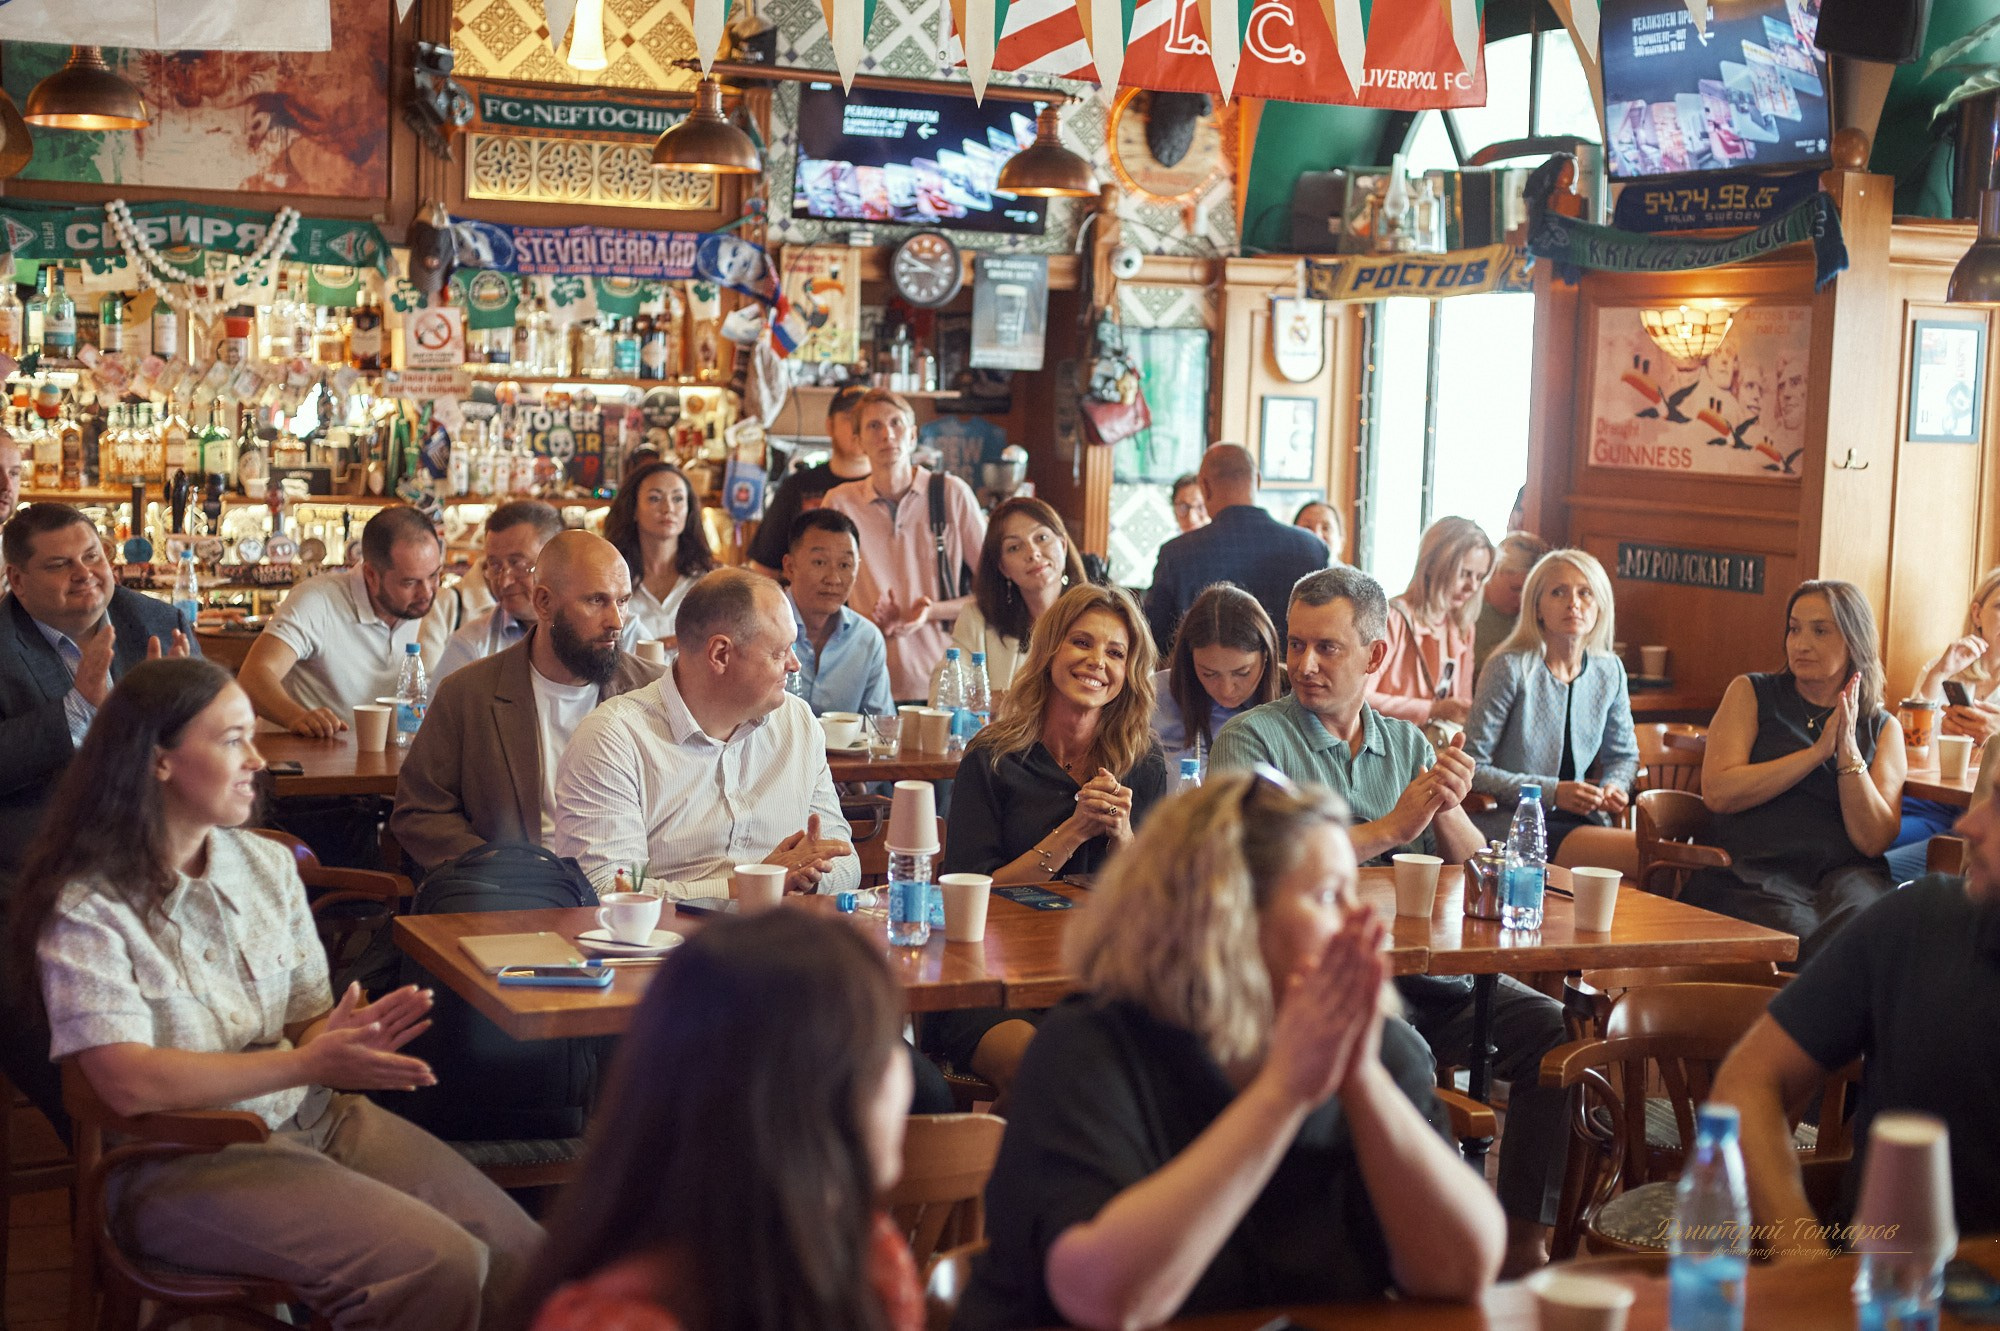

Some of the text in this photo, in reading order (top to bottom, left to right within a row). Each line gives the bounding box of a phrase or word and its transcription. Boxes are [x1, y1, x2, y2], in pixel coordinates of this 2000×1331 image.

[1360, 68, 1474, 91] LIVERPOOL FC
[1705, 211, 1761, 222] SWEDEN
[514, 236, 697, 269] STEVEN GERRARD
[1351, 258, 1489, 291] РОСТОВ
[1594, 438, 1692, 469] GUINNESS
[1625, 548, 1754, 589] МУРОМСКАЯ 14
